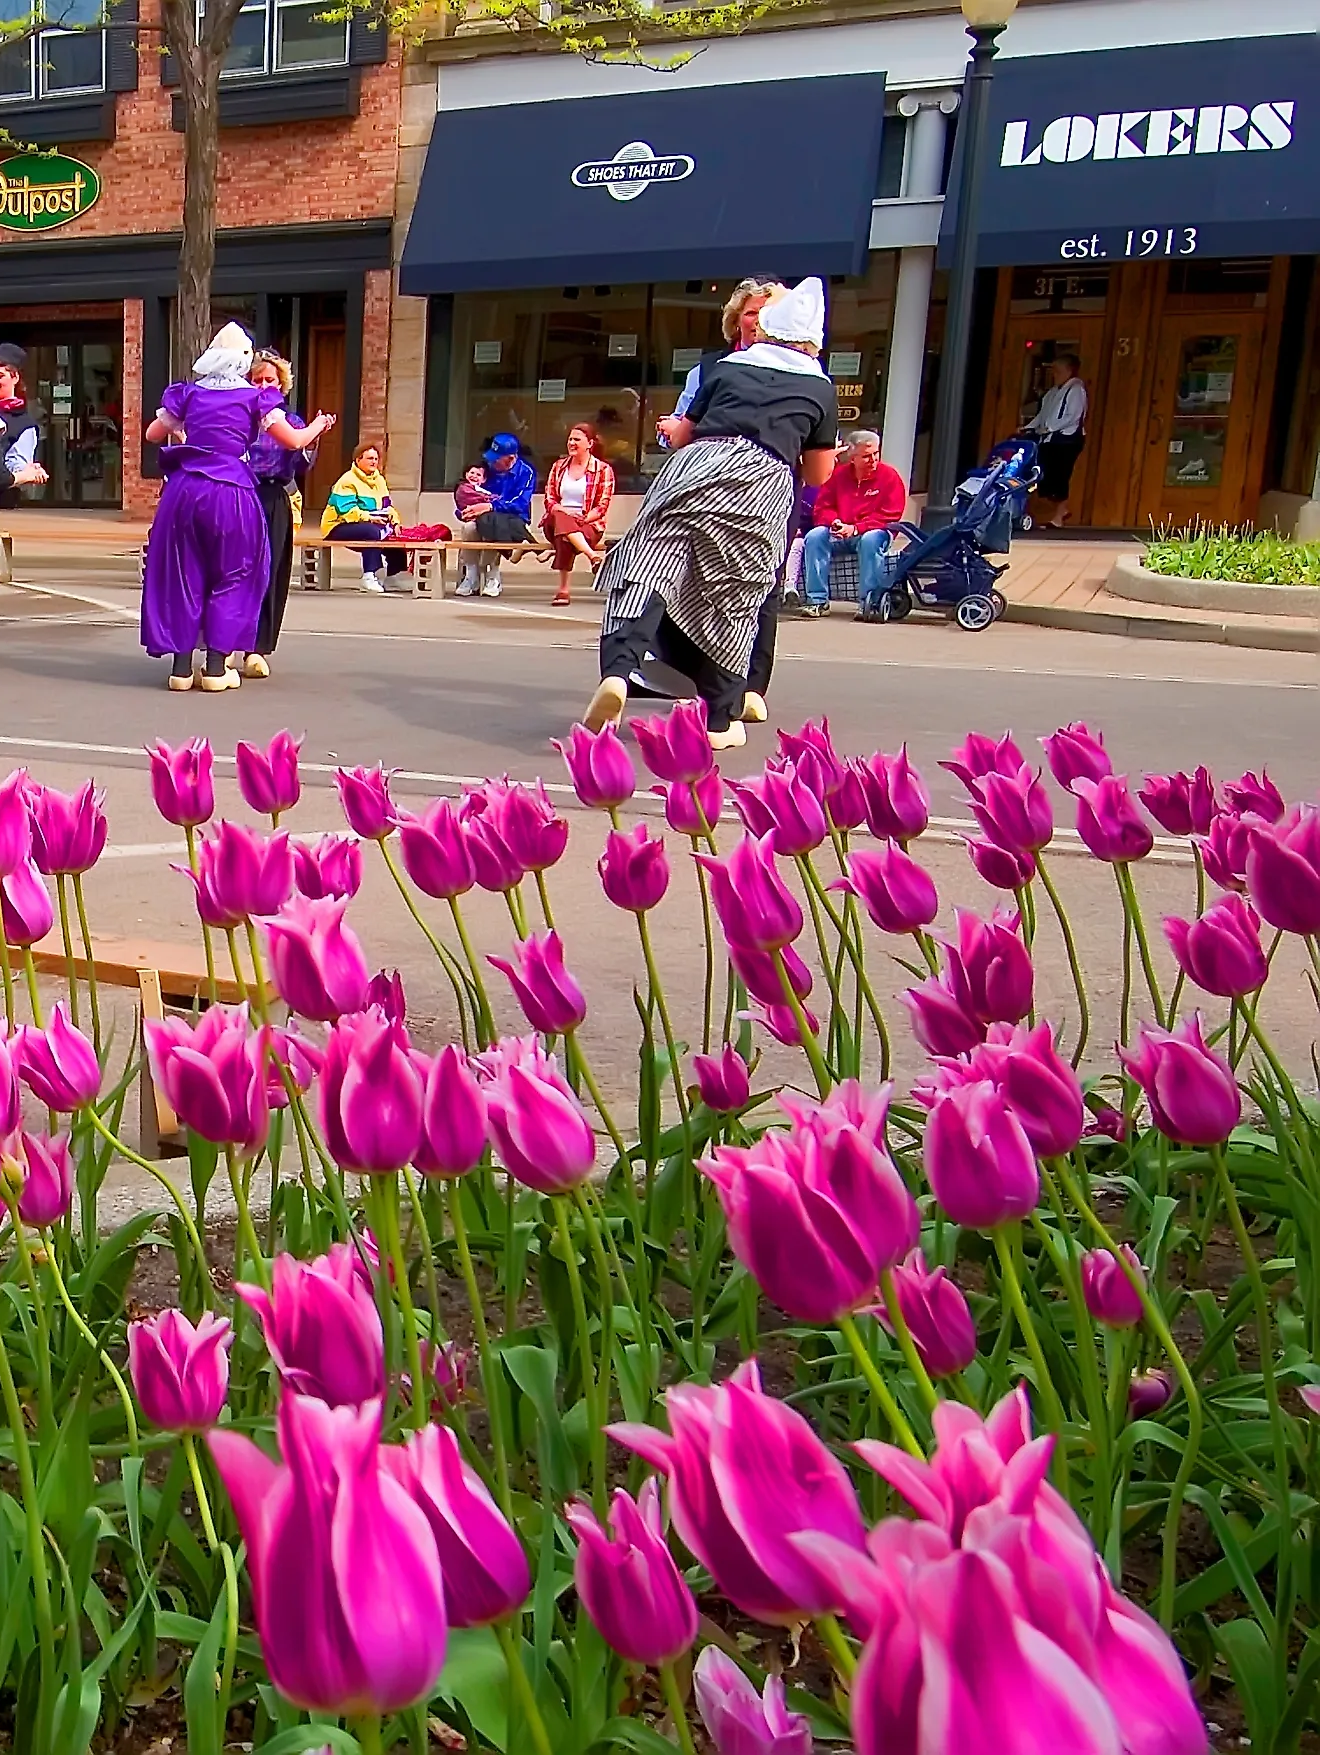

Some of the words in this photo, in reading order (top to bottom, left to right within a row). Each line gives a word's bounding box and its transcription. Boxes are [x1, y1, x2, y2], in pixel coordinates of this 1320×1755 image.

[1000, 101, 1295, 167] LOKERS
[588, 166, 626, 181] SHOES
[628, 163, 658, 178] THAT
[658, 162, 677, 176] FIT
[1060, 234, 1107, 259] est.
[1125, 228, 1198, 257] 1913
[1034, 277, 1054, 296] 31
[1117, 338, 1140, 357] 31
[837, 384, 864, 397] ERS
